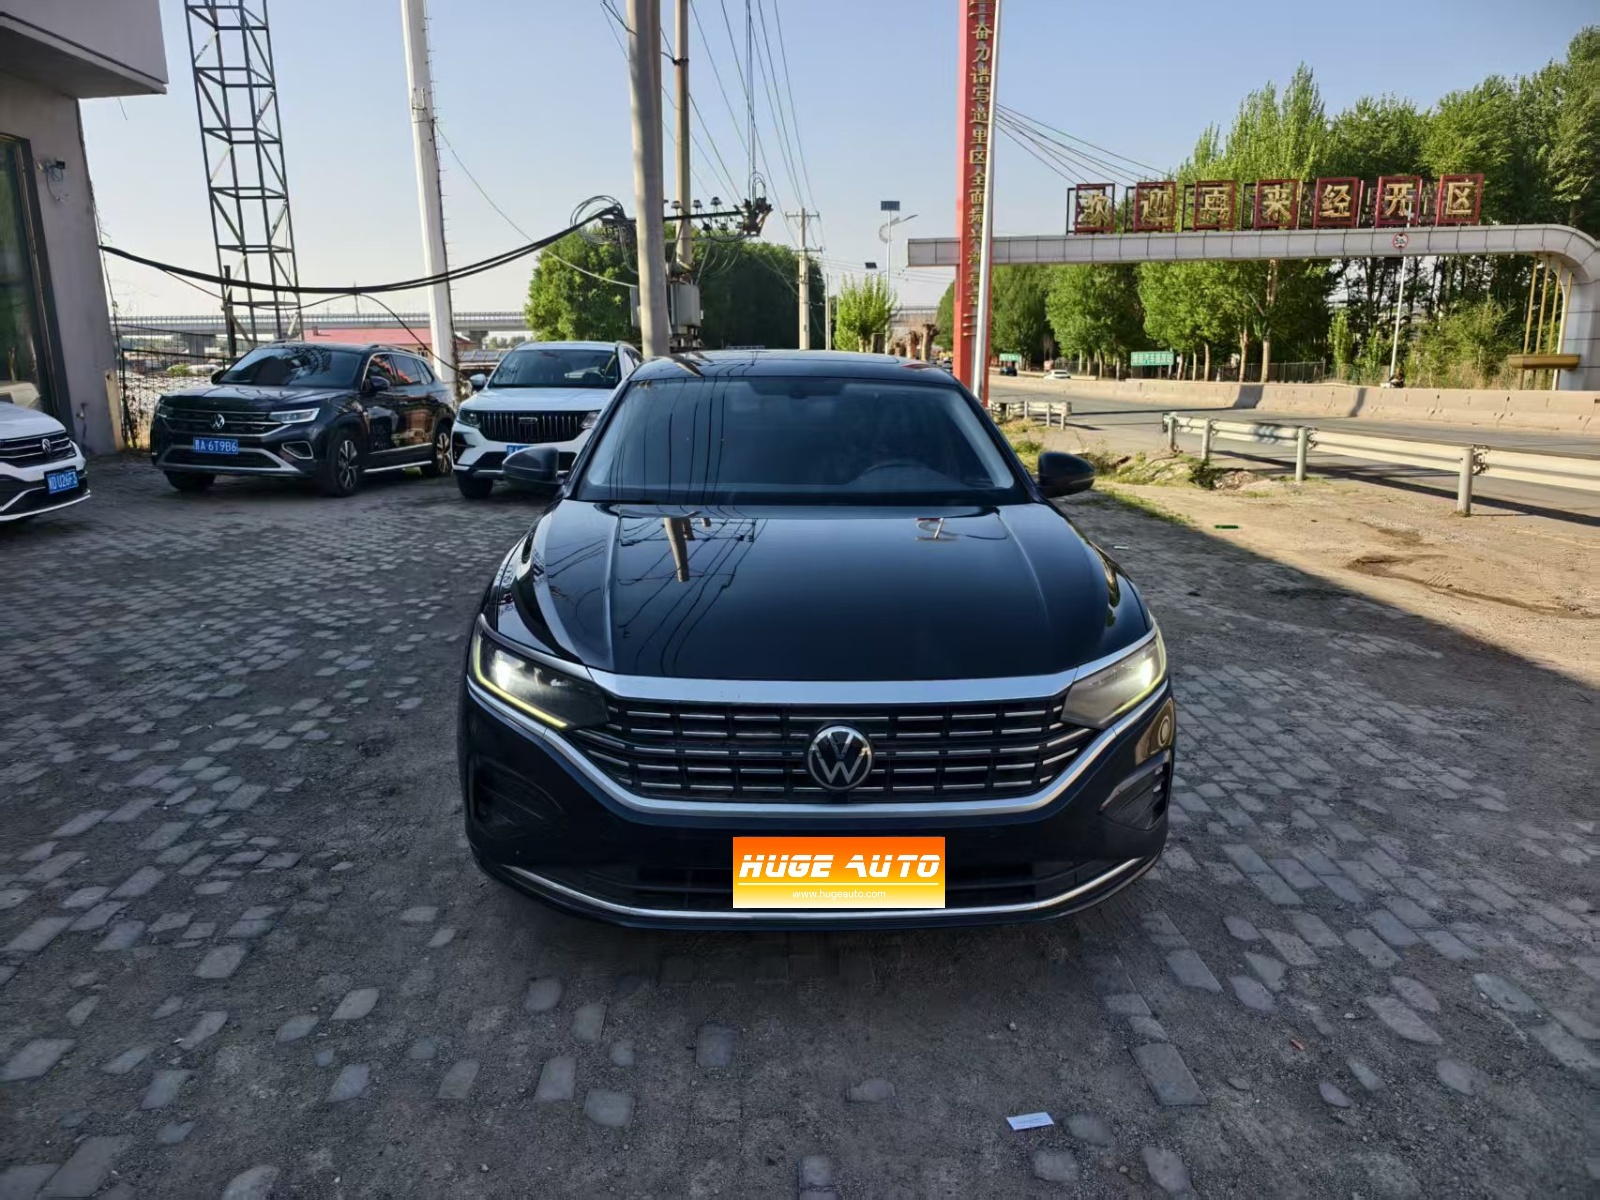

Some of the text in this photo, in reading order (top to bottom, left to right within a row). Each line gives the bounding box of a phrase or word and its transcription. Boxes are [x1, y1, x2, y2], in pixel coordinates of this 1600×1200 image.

[1077, 181, 1474, 227] 欢迎再来经开区
